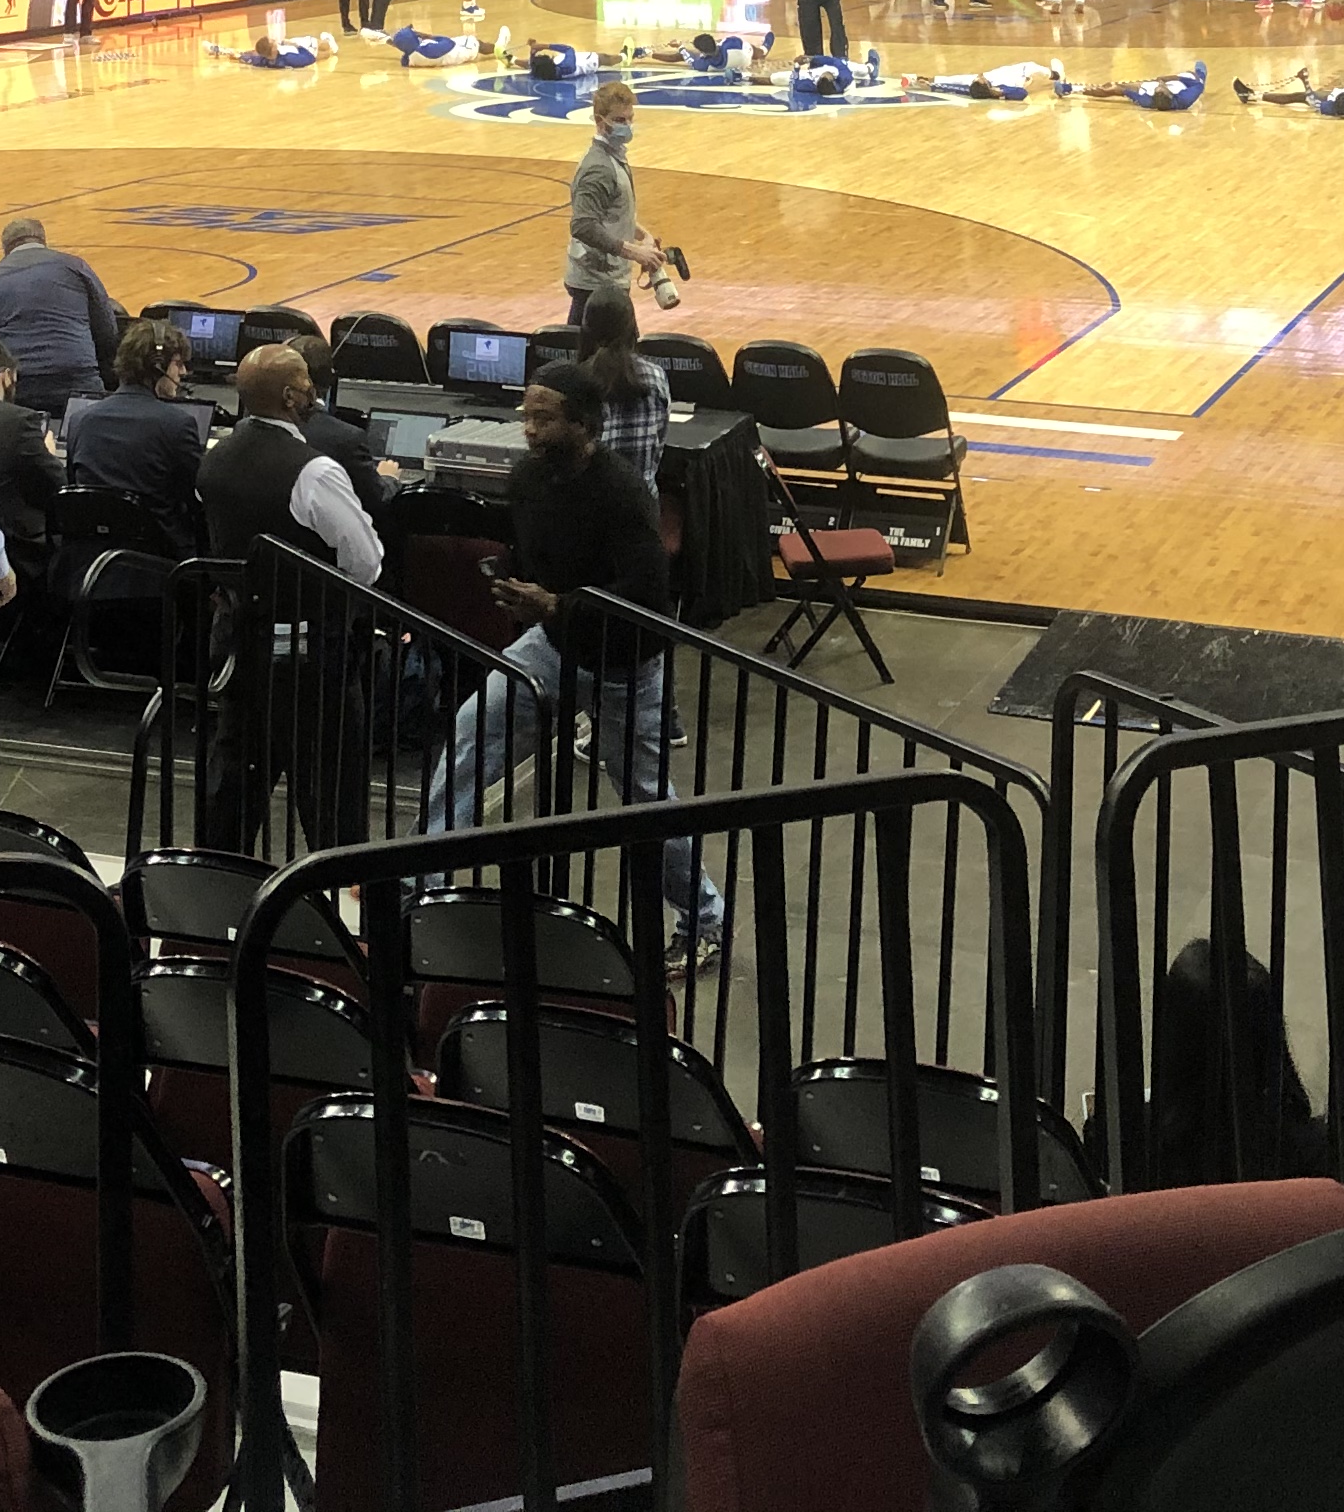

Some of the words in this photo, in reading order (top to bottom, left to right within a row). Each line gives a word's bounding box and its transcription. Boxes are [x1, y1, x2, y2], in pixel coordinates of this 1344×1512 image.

[828, 516, 835, 526] 2
[889, 527, 905, 537] THE
[900, 537, 931, 548] FAMILY
